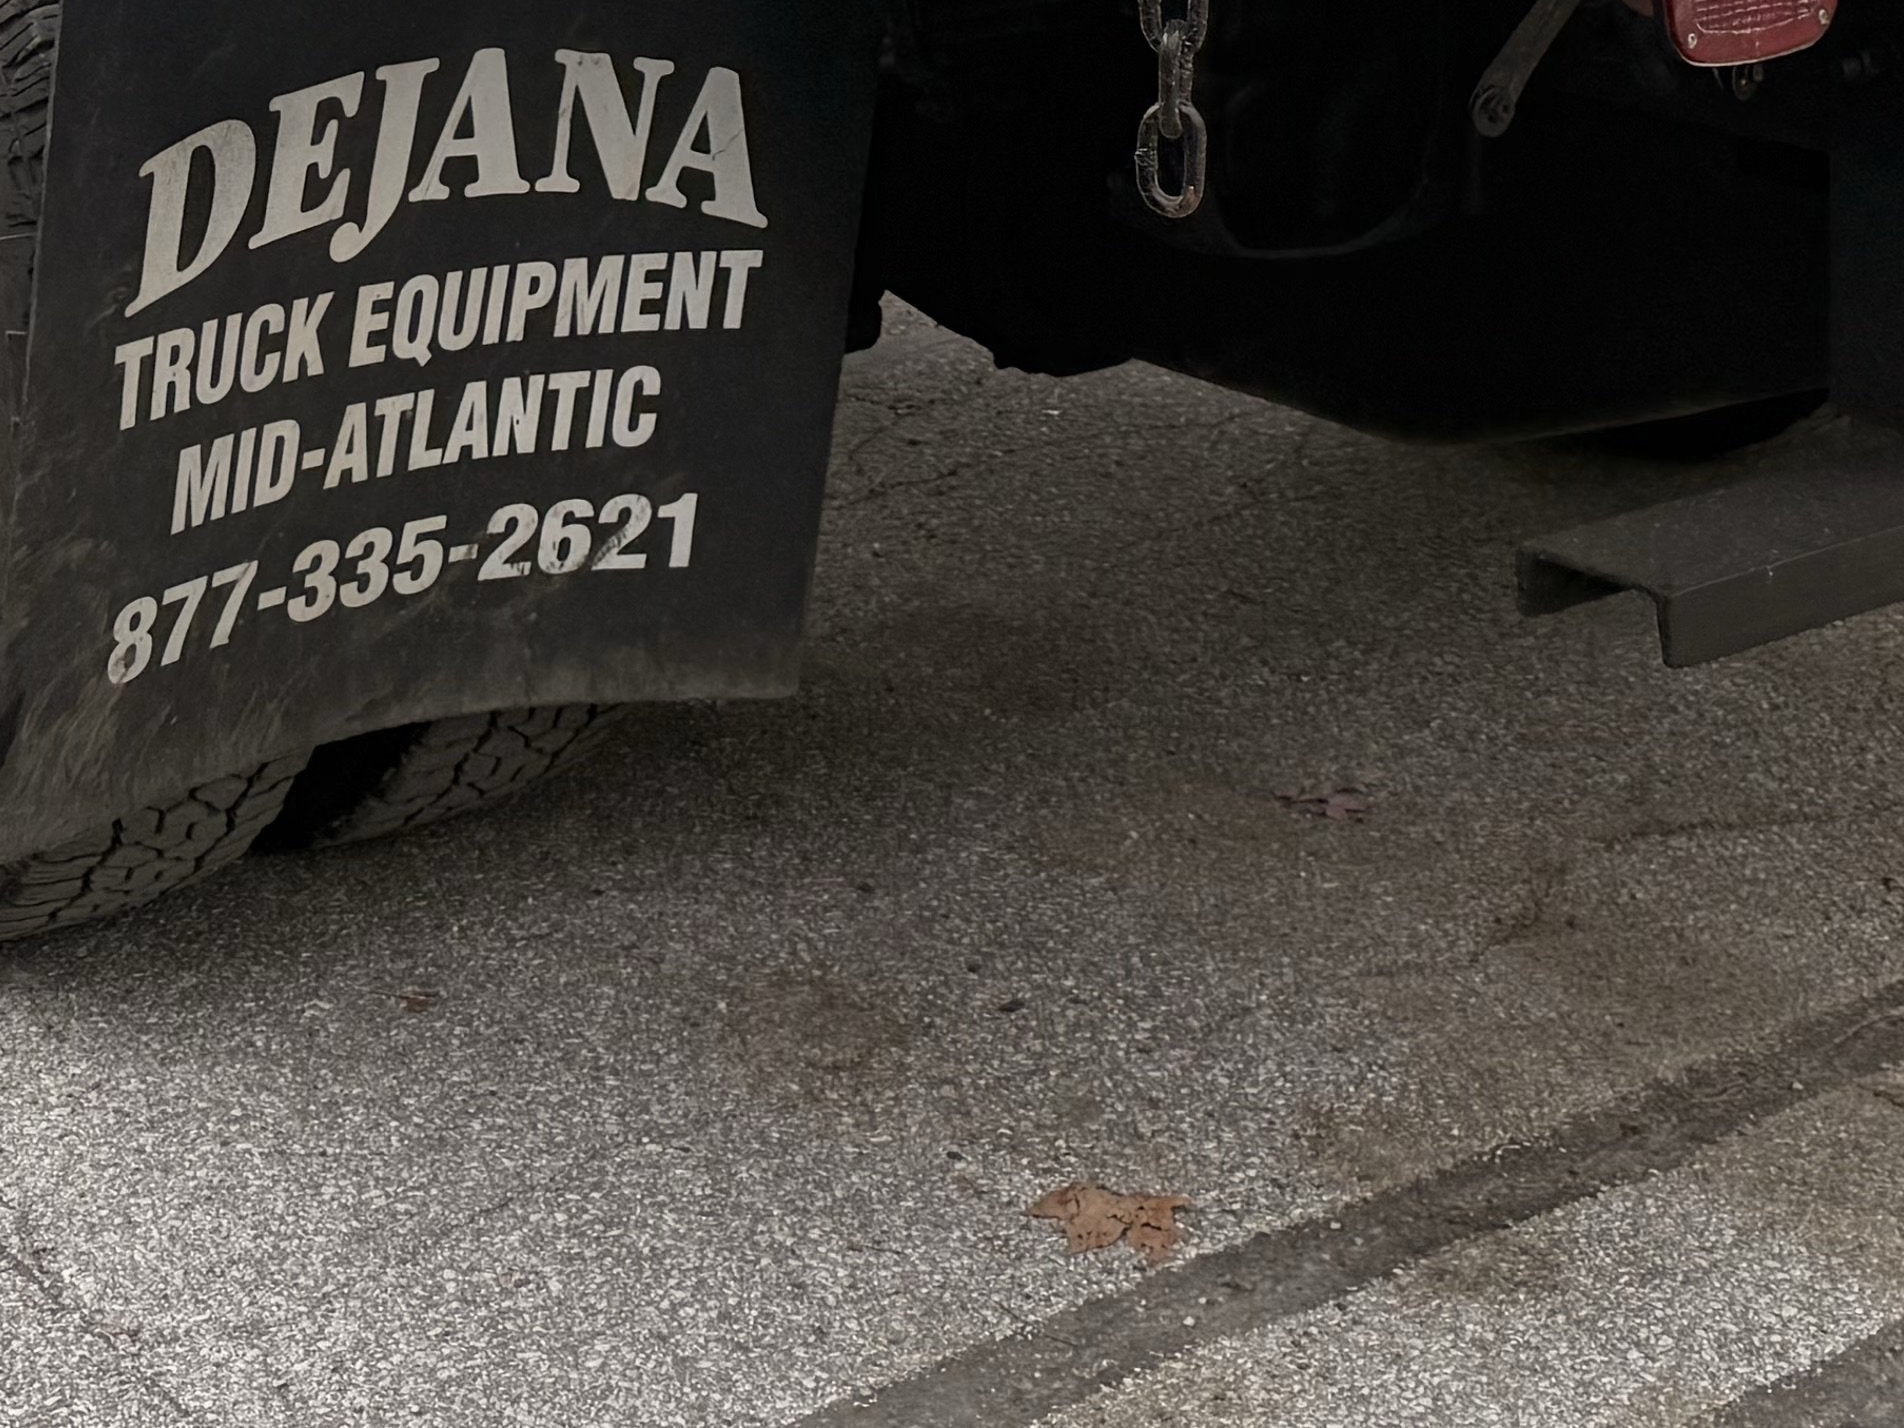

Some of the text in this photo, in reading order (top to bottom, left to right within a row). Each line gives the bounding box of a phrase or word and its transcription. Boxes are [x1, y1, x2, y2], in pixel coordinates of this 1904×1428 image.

[124, 48, 768, 317] DEJANA
[114, 248, 763, 431] TRUCK EQUIPMENT
[170, 365, 662, 535] MID-ATLANTIC
[106, 492, 700, 685] 877-335-2621
